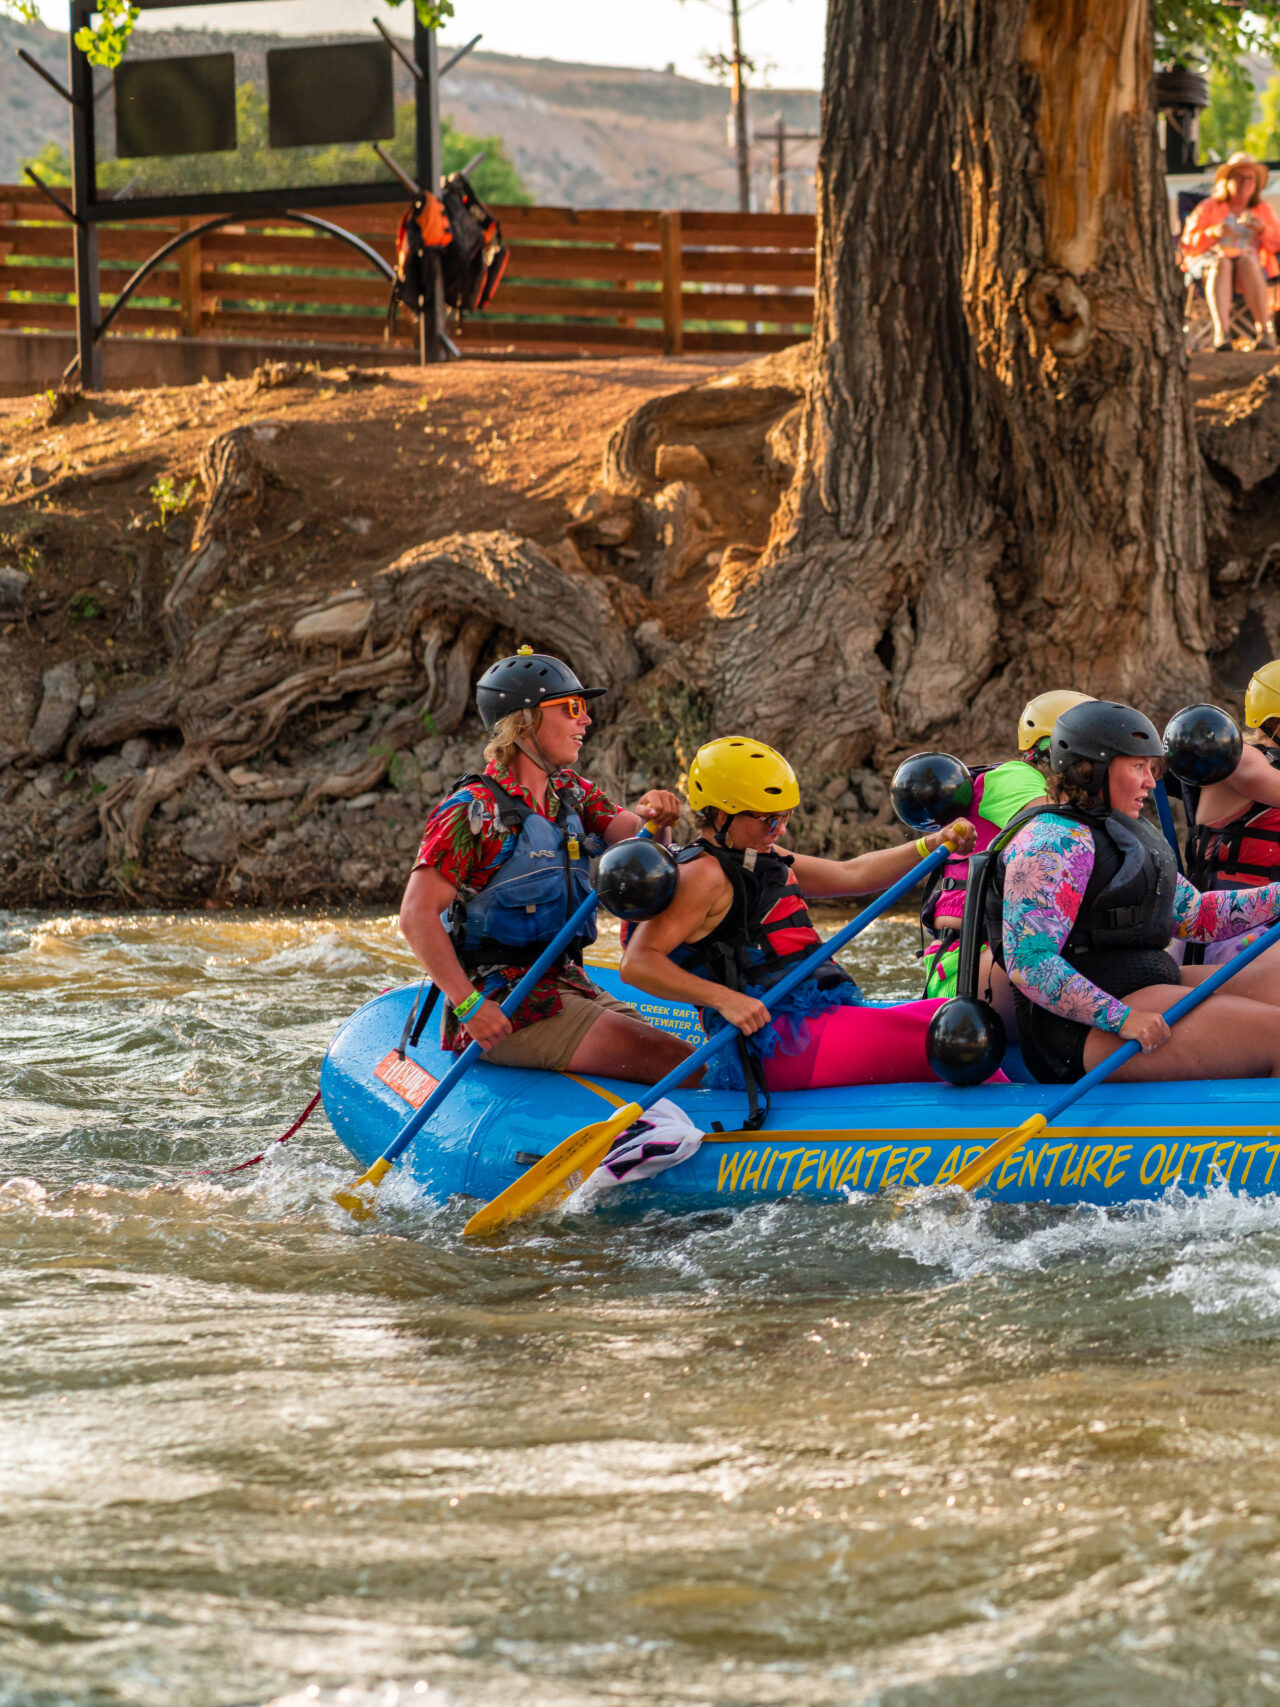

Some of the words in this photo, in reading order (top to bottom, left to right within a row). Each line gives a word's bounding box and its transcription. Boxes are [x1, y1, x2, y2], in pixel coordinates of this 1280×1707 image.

[529, 849, 556, 859] NRS
[640, 1003, 671, 1016] CREEK
[382, 1059, 431, 1100] HYSIDE
[717, 1145, 932, 1191] WHITEWATER
[933, 1142, 1134, 1190] ADENTURE
